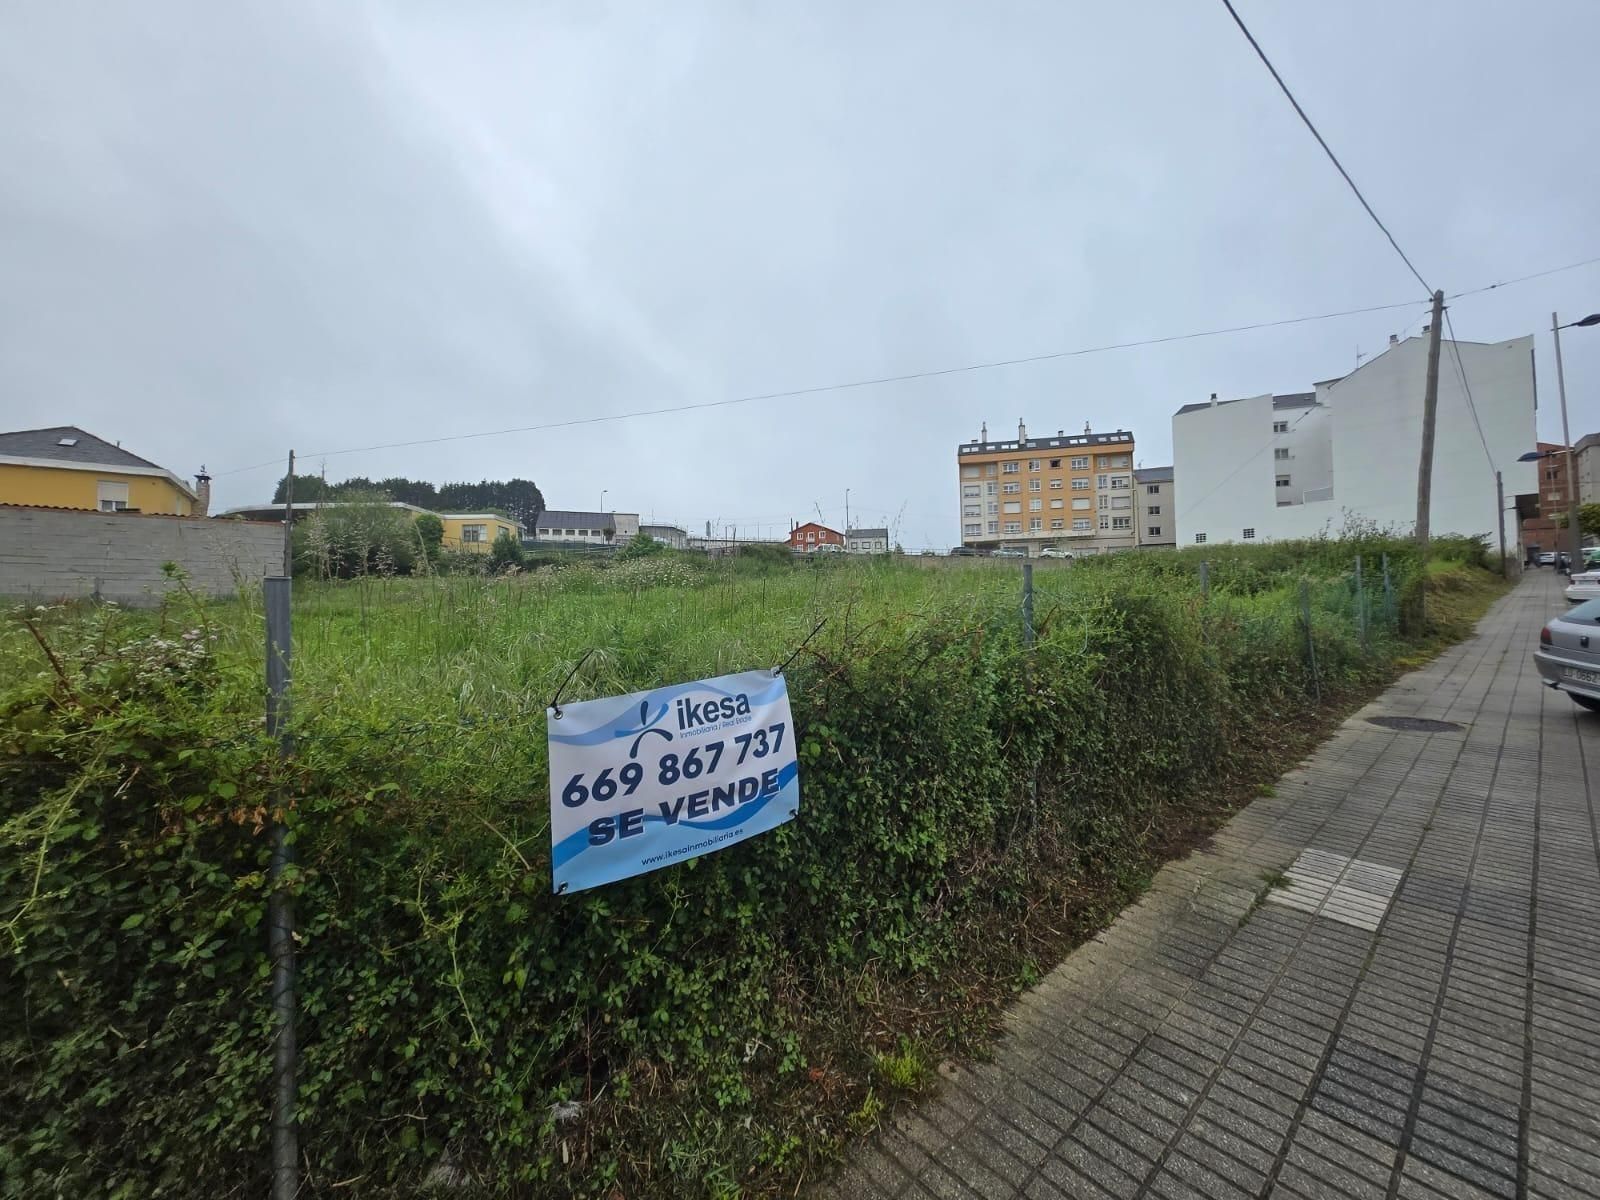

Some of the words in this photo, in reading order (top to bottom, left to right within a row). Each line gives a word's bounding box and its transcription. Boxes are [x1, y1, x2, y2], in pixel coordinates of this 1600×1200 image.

[677, 693, 751, 730] ikesa
[561, 762, 643, 808] 669
[658, 740, 725, 786] 867
[735, 722, 786, 765] 737
[588, 808, 644, 846] SE
[659, 768, 780, 826] VENDE
[641, 828, 744, 866] www.ikesainmobiliaria.es
